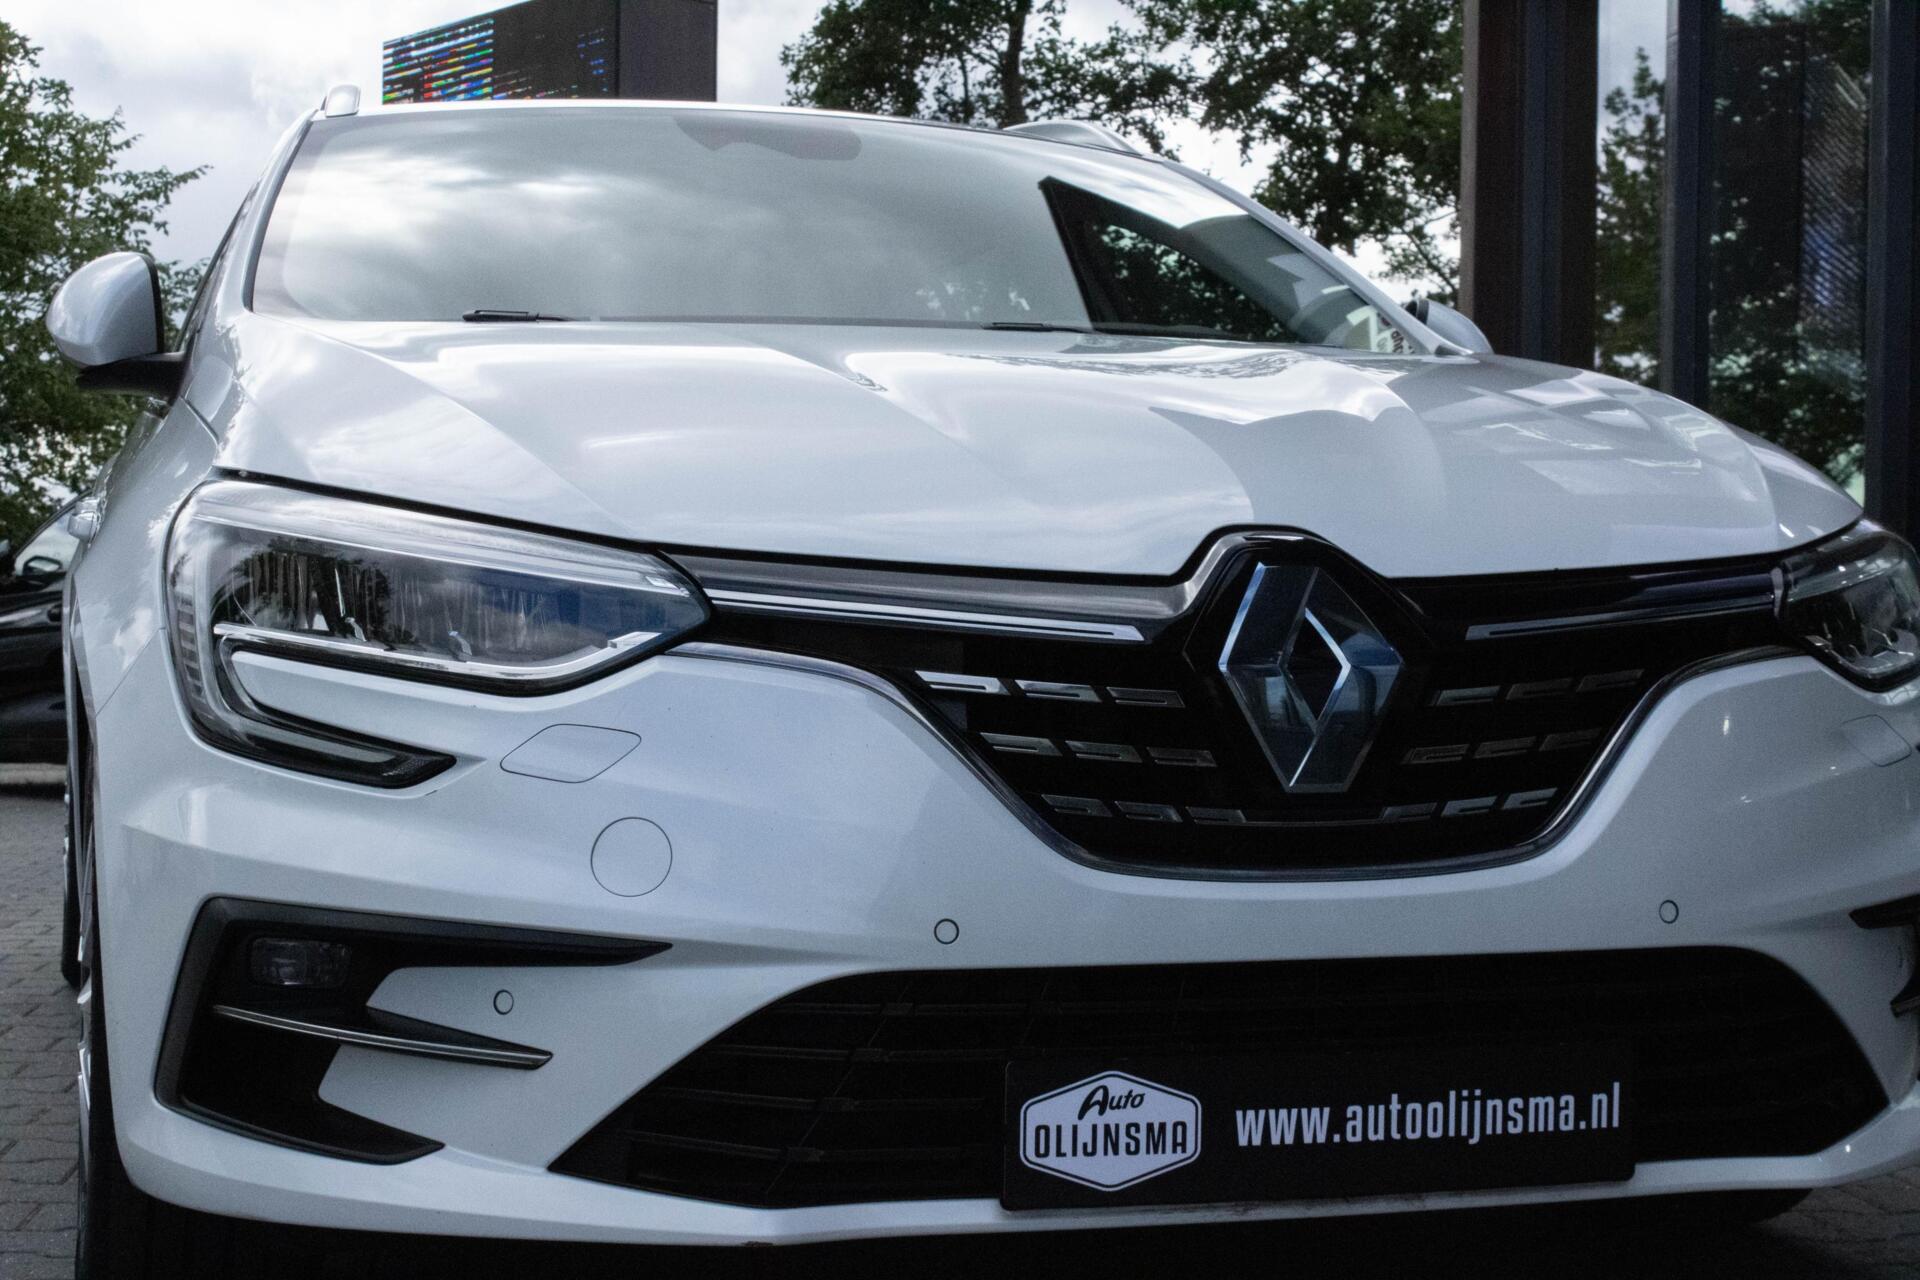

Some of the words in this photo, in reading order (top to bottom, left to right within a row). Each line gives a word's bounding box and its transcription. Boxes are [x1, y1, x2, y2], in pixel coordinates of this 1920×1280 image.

[1078, 1085, 1145, 1120] Auto
[1236, 1082, 1620, 1146] www.autoolijnsma.nl
[1034, 1120, 1188, 1158] OLIJNSMA
